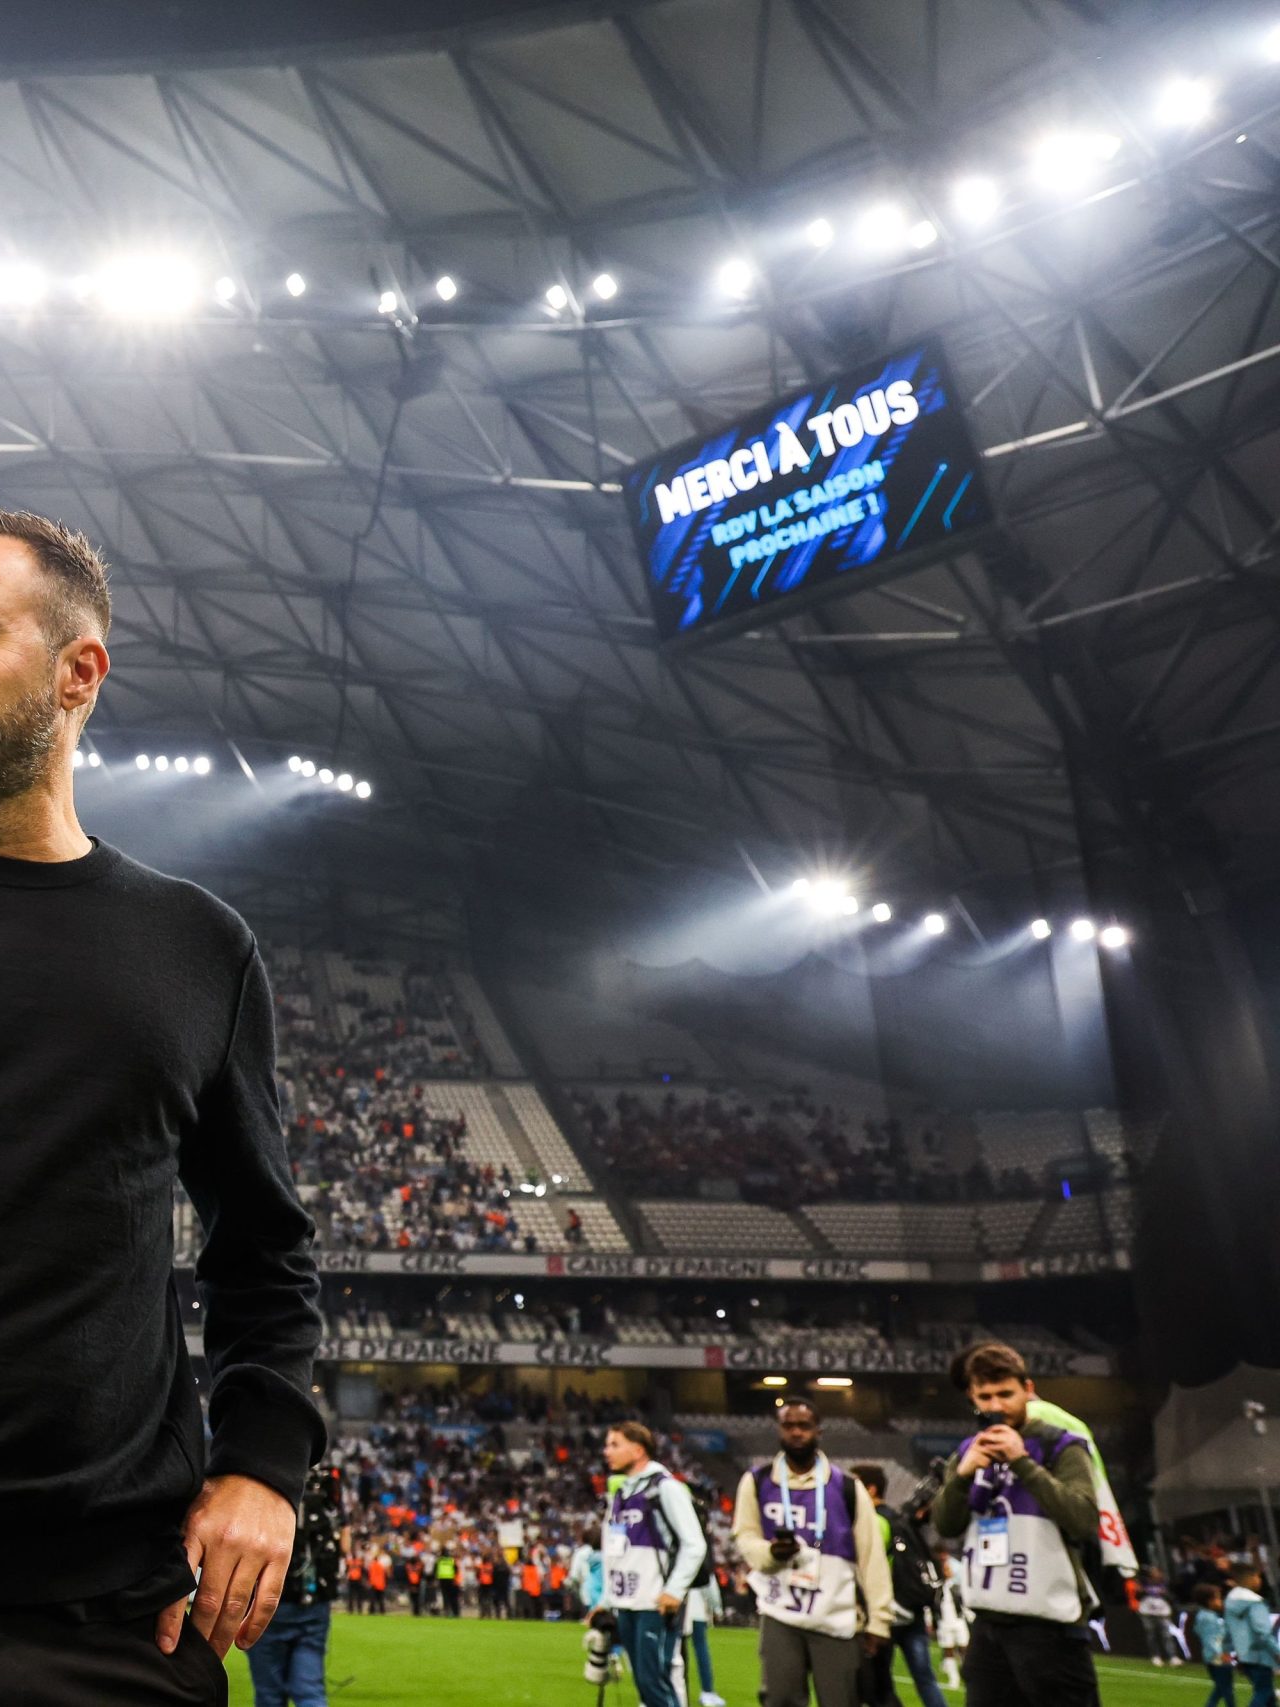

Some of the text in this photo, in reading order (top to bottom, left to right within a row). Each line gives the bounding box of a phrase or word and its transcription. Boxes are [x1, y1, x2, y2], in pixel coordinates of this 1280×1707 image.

[654, 379, 920, 524] MERCI À TOUS
[728, 491, 881, 570] PROCHAINE !
[758, 497, 795, 528] LA
[792, 459, 886, 514] SAISON
